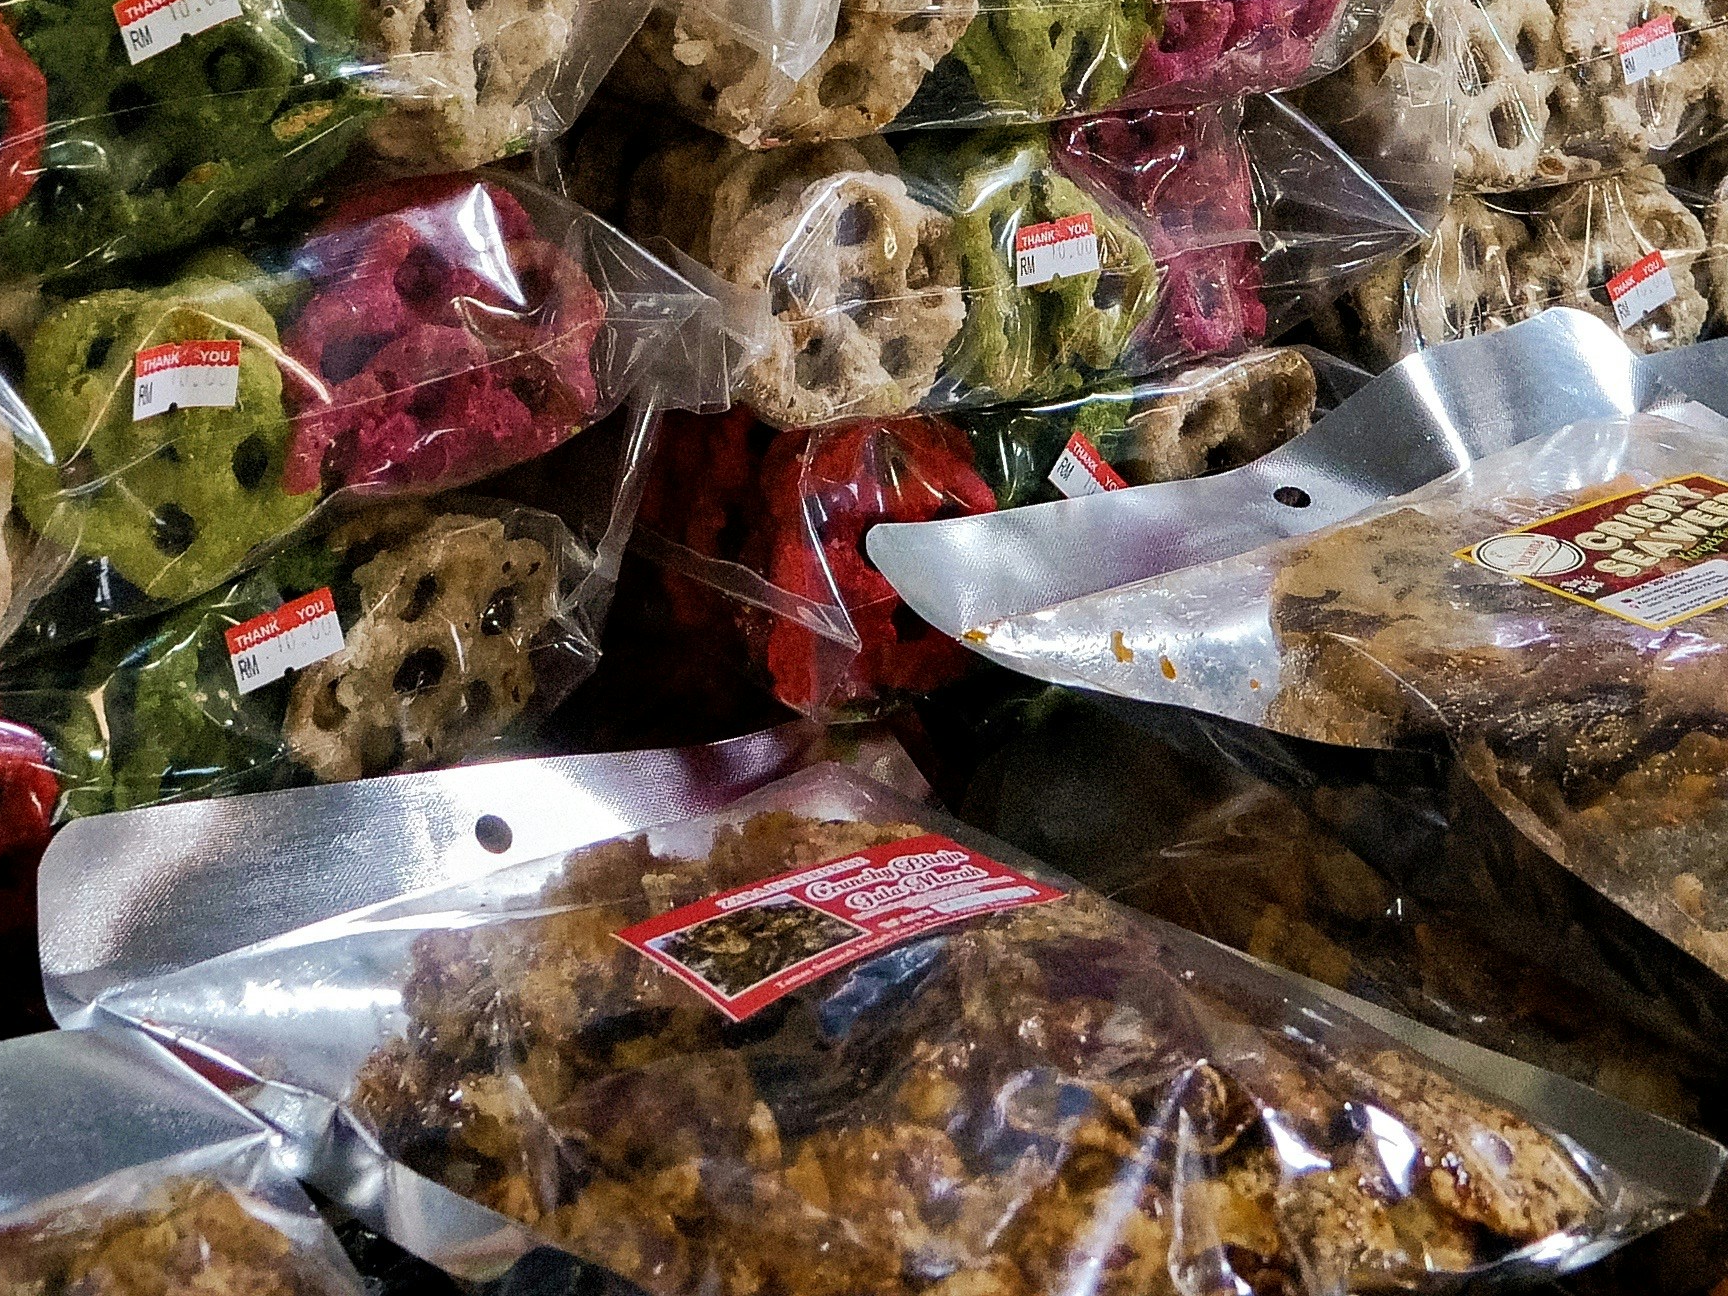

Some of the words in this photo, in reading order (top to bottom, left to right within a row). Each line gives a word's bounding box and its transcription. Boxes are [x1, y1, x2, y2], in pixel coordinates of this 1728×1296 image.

[129, 22, 152, 49] RM
[1020, 227, 1054, 248] THANK
[1068, 222, 1089, 236] YOU
[1019, 256, 1035, 277] RM
[142, 352, 181, 371] THANK
[200, 350, 231, 363] YOU
[138, 382, 153, 399] RM
[1072, 441, 1099, 473] THANK
[1573, 483, 1705, 550] CRISPY
[233, 622, 279, 651] THANK
[295, 599, 325, 621] YOU
[237, 655, 259, 680] RM
[806, 866, 894, 901] Crunchy
[845, 882, 906, 910] Gula
[904, 866, 987, 894] Merah
